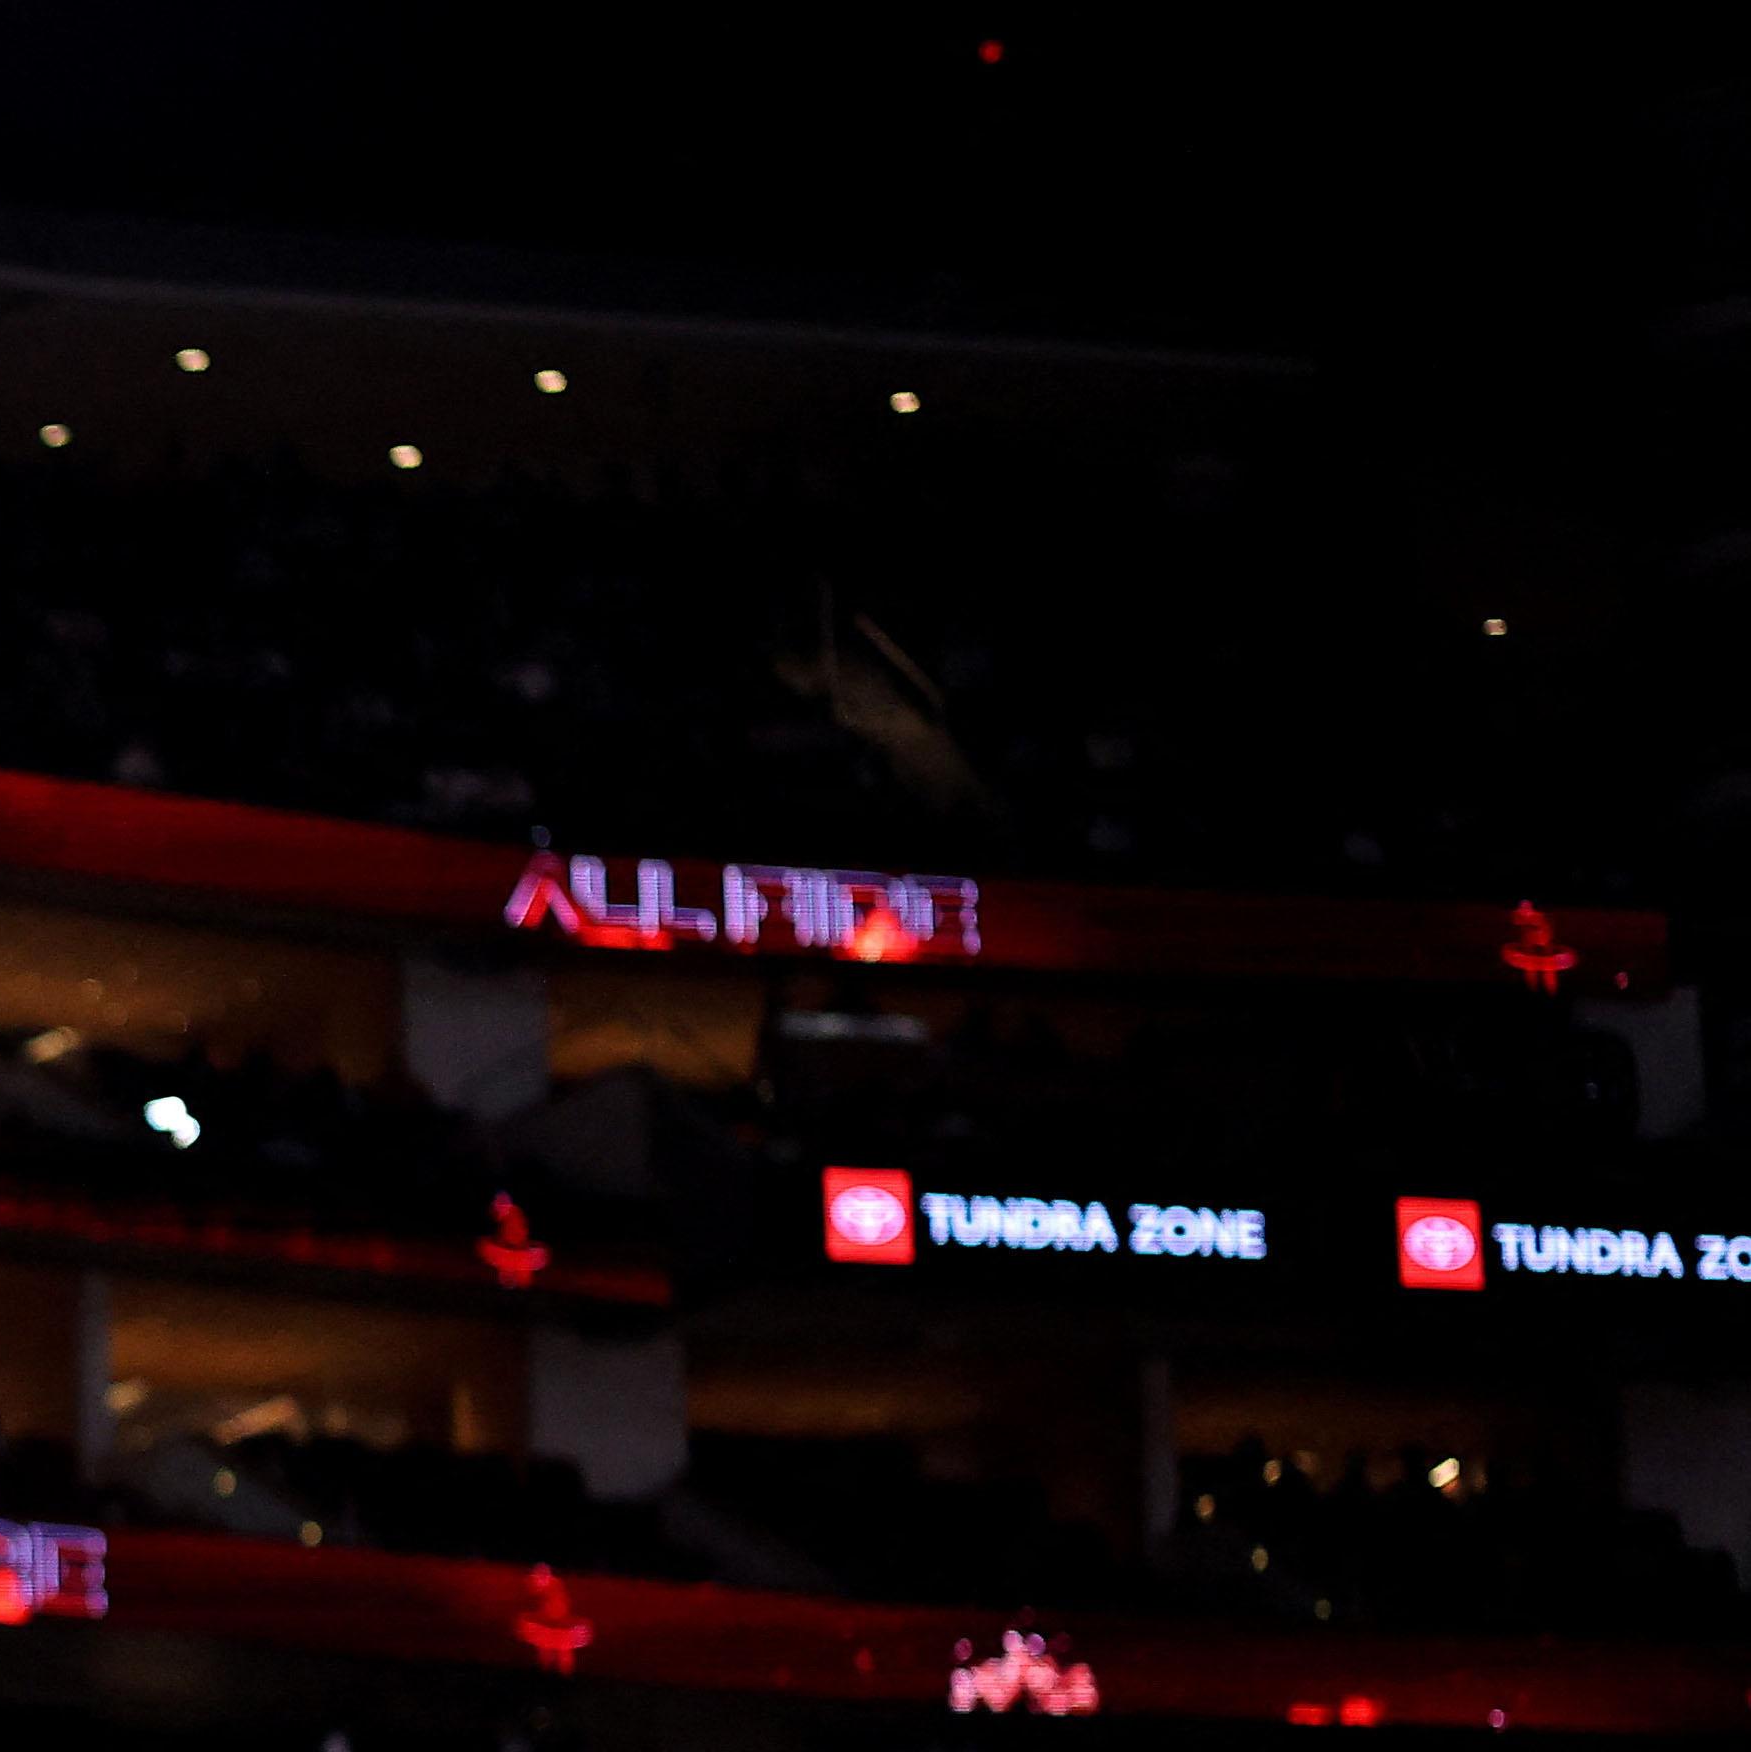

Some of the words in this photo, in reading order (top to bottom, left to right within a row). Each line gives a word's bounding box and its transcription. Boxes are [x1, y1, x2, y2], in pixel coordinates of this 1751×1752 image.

[503, 849, 717, 942] ALL
[920, 1192, 1119, 1253] TUNDRA
[1128, 1203, 1267, 1260] ZONE
[1491, 1223, 1685, 1279] TUNDRA
